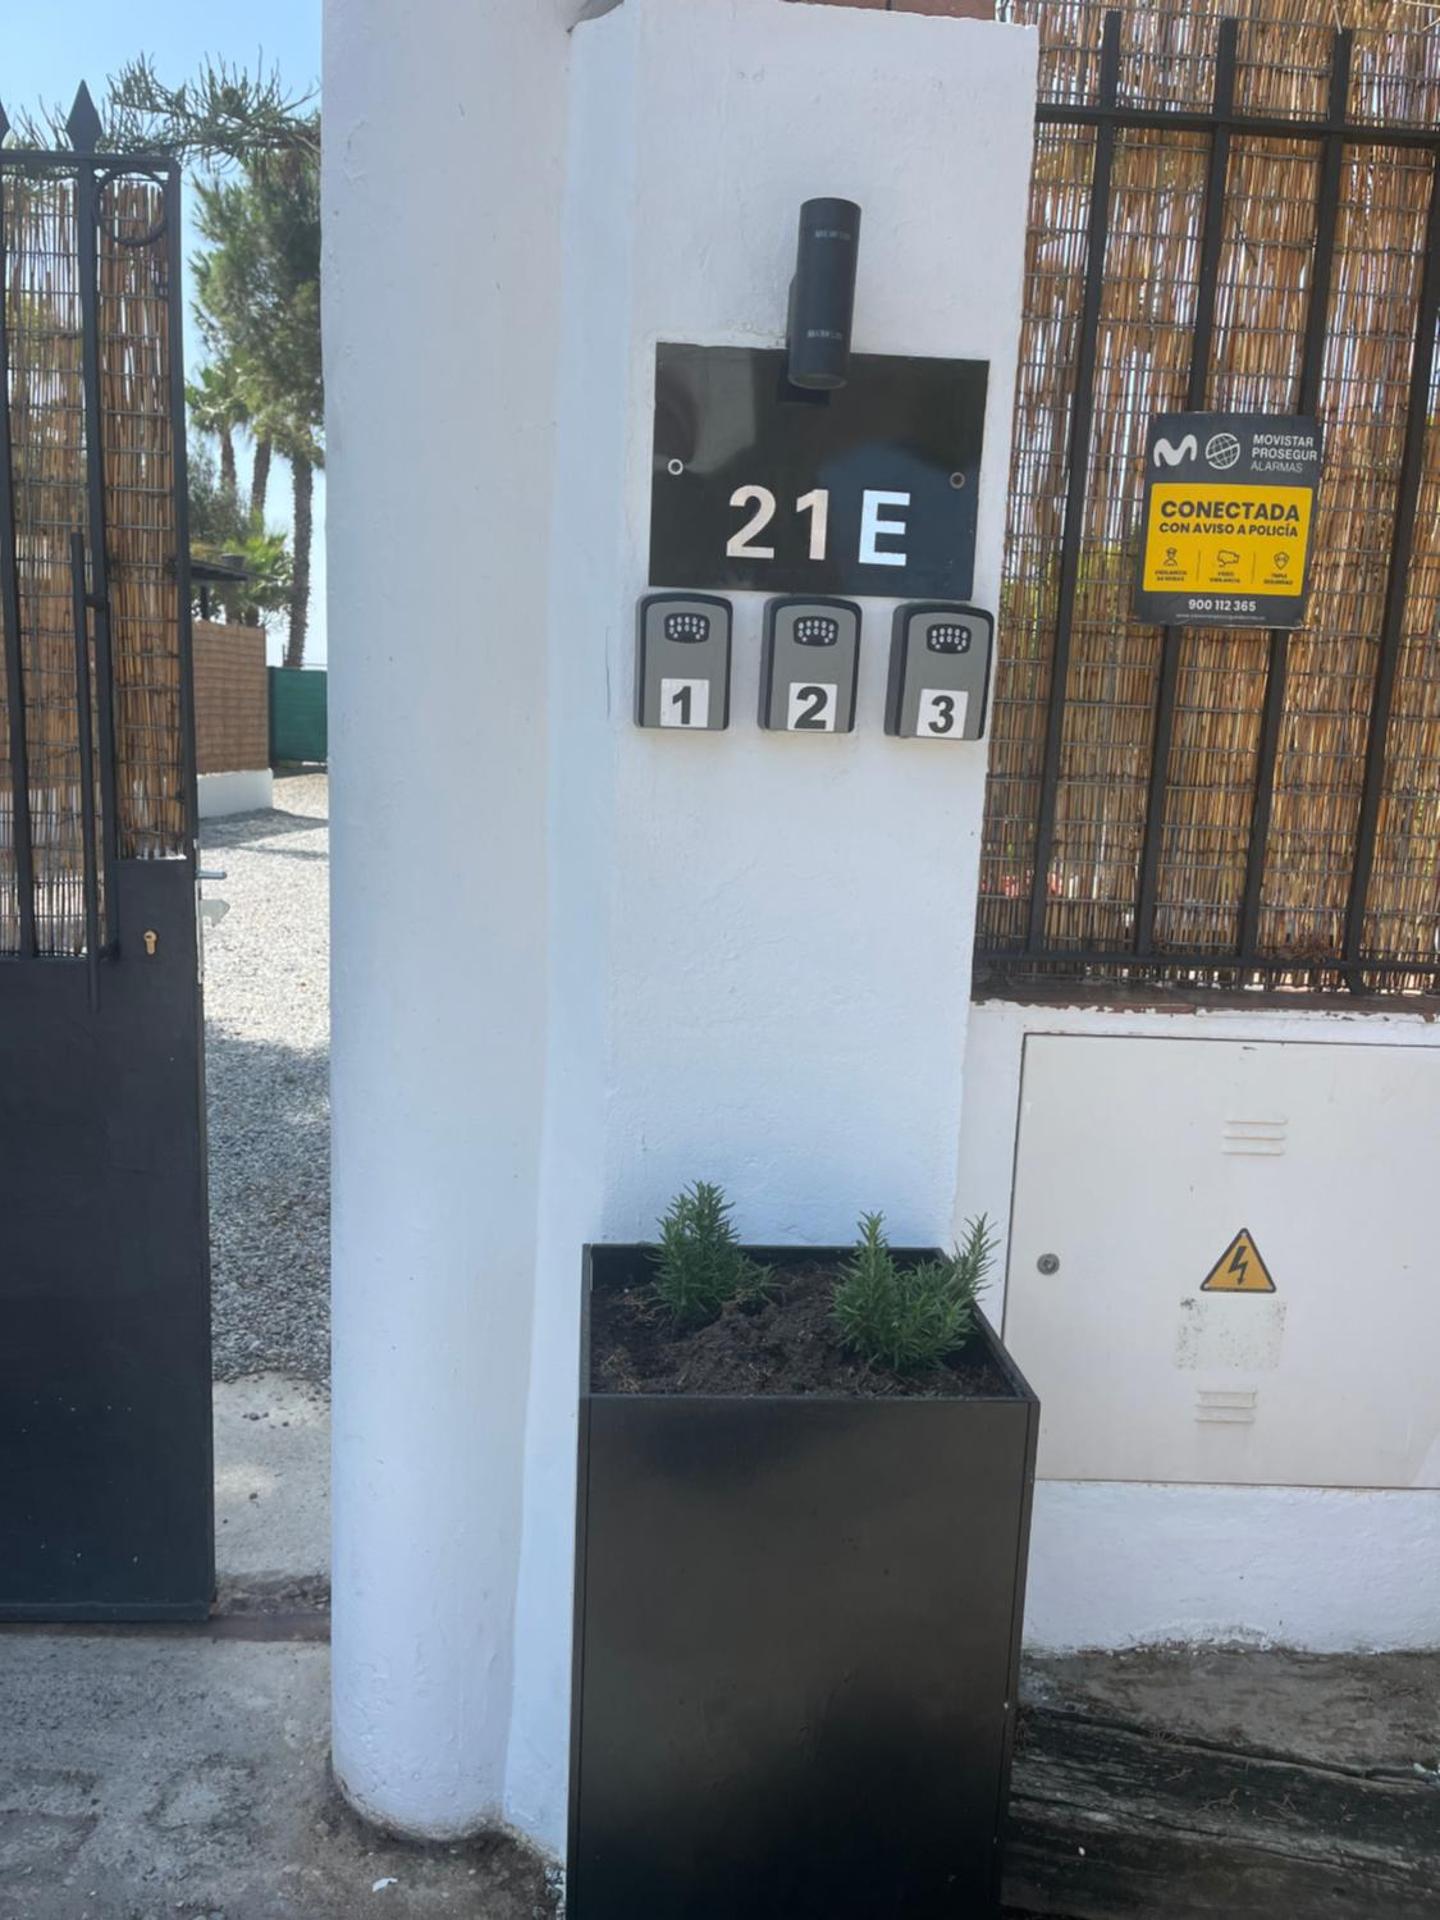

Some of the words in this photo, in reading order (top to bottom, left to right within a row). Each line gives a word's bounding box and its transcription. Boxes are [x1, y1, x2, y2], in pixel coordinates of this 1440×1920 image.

[1253, 434, 1314, 448] MOVISTAR
[1251, 447, 1318, 461] PROSEGUR
[1250, 460, 1303, 473] ALARMAS
[1161, 501, 1300, 522] CONECTADA
[1159, 523, 1190, 533] CON
[1192, 523, 1235, 534] AVISO
[1237, 525, 1246, 535] A
[1249, 523, 1298, 537] POLICÍA
[1188, 599, 1212, 610] 900
[1215, 600, 1231, 611] 112
[1233, 600, 1257, 612] 365
[671, 685, 692, 725] 1
[793, 686, 829, 730] 2
[928, 695, 955, 734] 3
